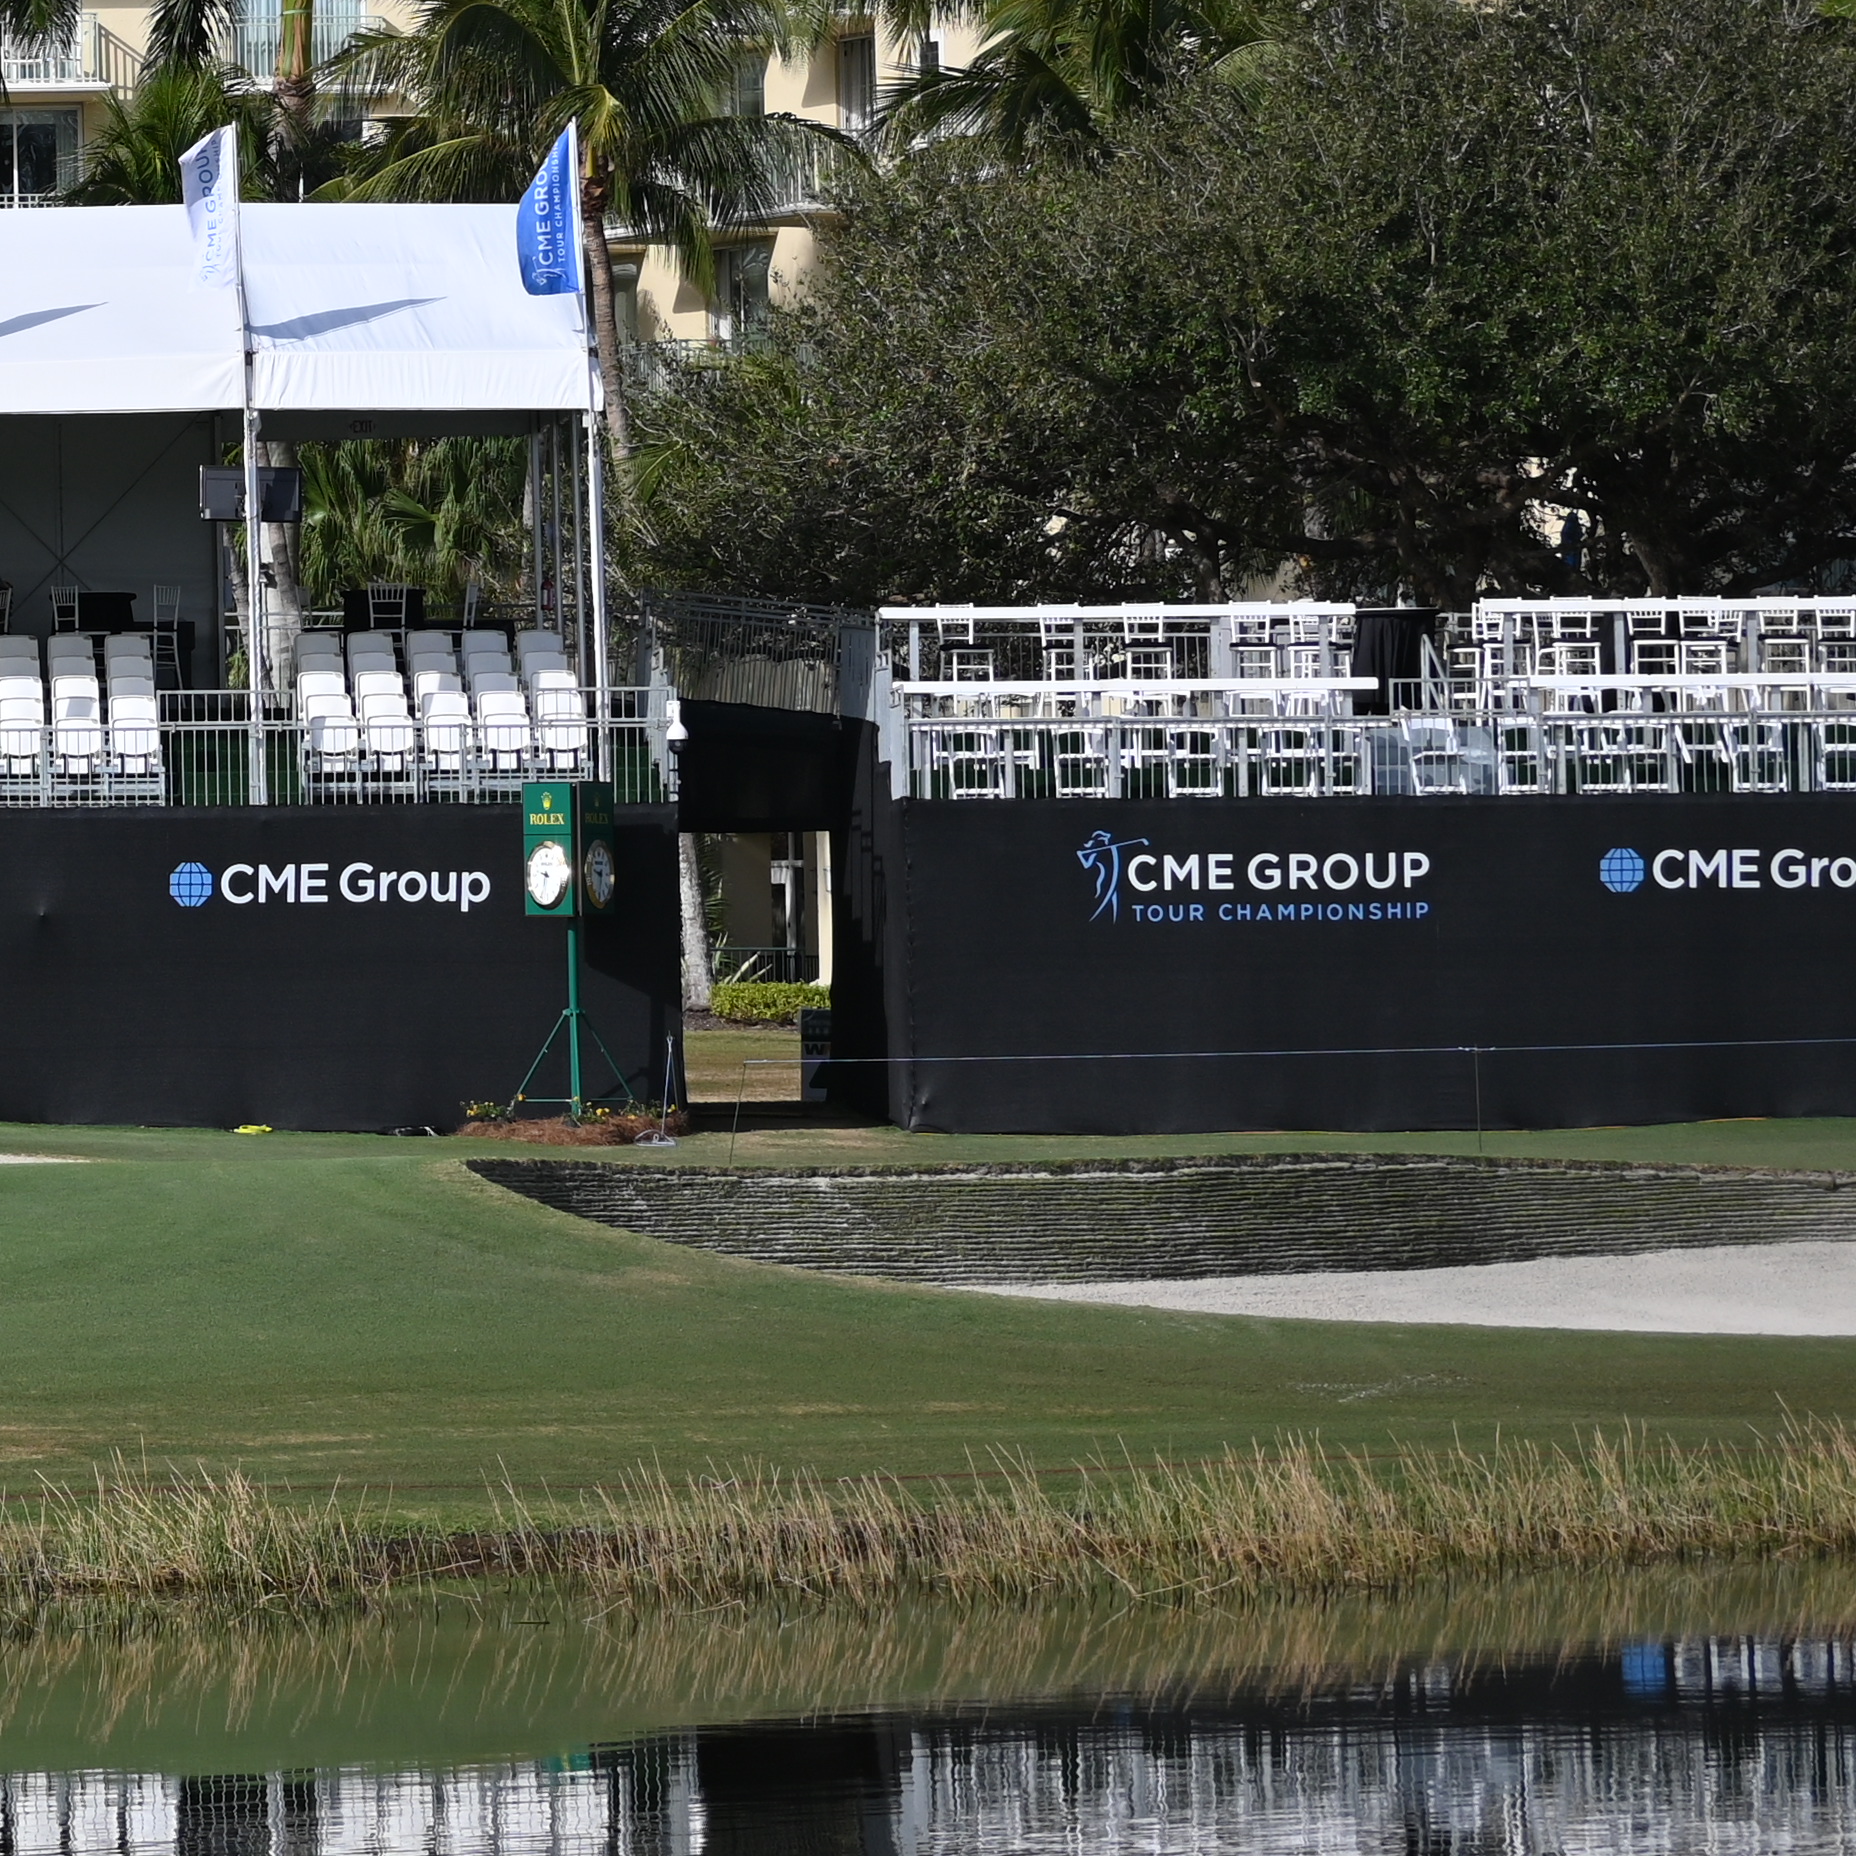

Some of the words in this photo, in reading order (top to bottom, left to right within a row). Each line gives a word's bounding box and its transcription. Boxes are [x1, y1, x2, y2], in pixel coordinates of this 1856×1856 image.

[196, 149, 217, 213] GROU
[536, 220, 554, 265] CME
[530, 814, 564, 825] ROLEX
[221, 863, 328, 904] CME
[340, 862, 490, 912] Group
[1128, 854, 1234, 891] CME
[1248, 852, 1429, 890] GROUP
[1653, 850, 1760, 888] CME
[1771, 849, 1856, 888] Gro
[1132, 904, 1203, 921] TOUR
[1219, 902, 1428, 920] CHAMPIONSHIP
